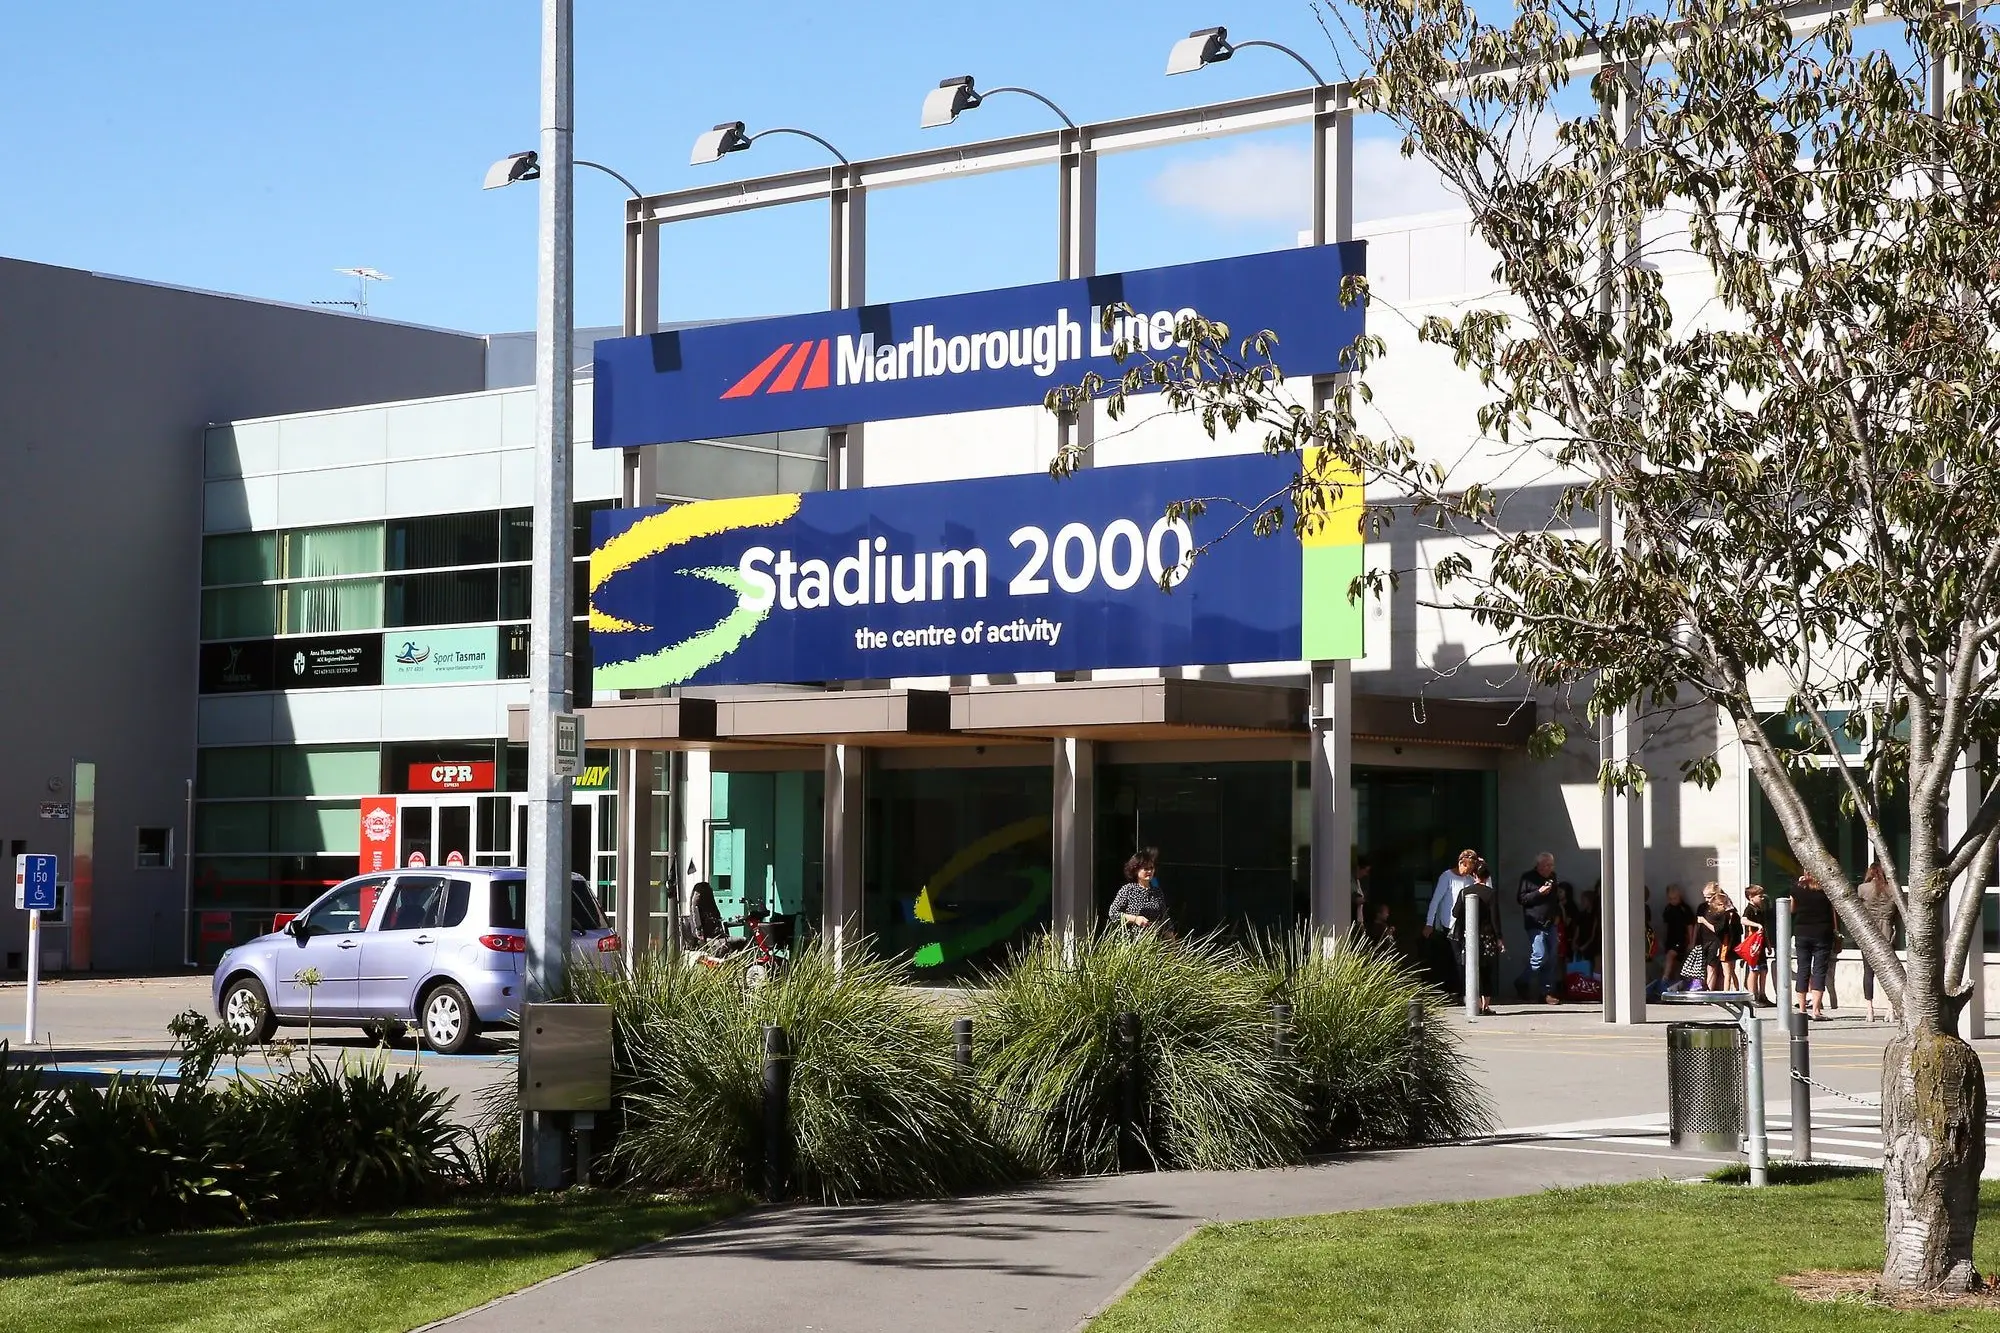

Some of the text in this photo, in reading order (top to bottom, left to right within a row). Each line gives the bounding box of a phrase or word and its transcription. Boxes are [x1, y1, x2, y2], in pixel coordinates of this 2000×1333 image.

[836, 308, 1081, 386] Marlborough
[738, 515, 1193, 612] Stadium 2000
[855, 618, 1062, 649] the centre of activity
[433, 651, 486, 665] Sport Tasman
[431, 765, 473, 782] CPR
[572, 766, 610, 786] WAY
[37, 858, 46, 870] P
[33, 872, 48, 882] 150
